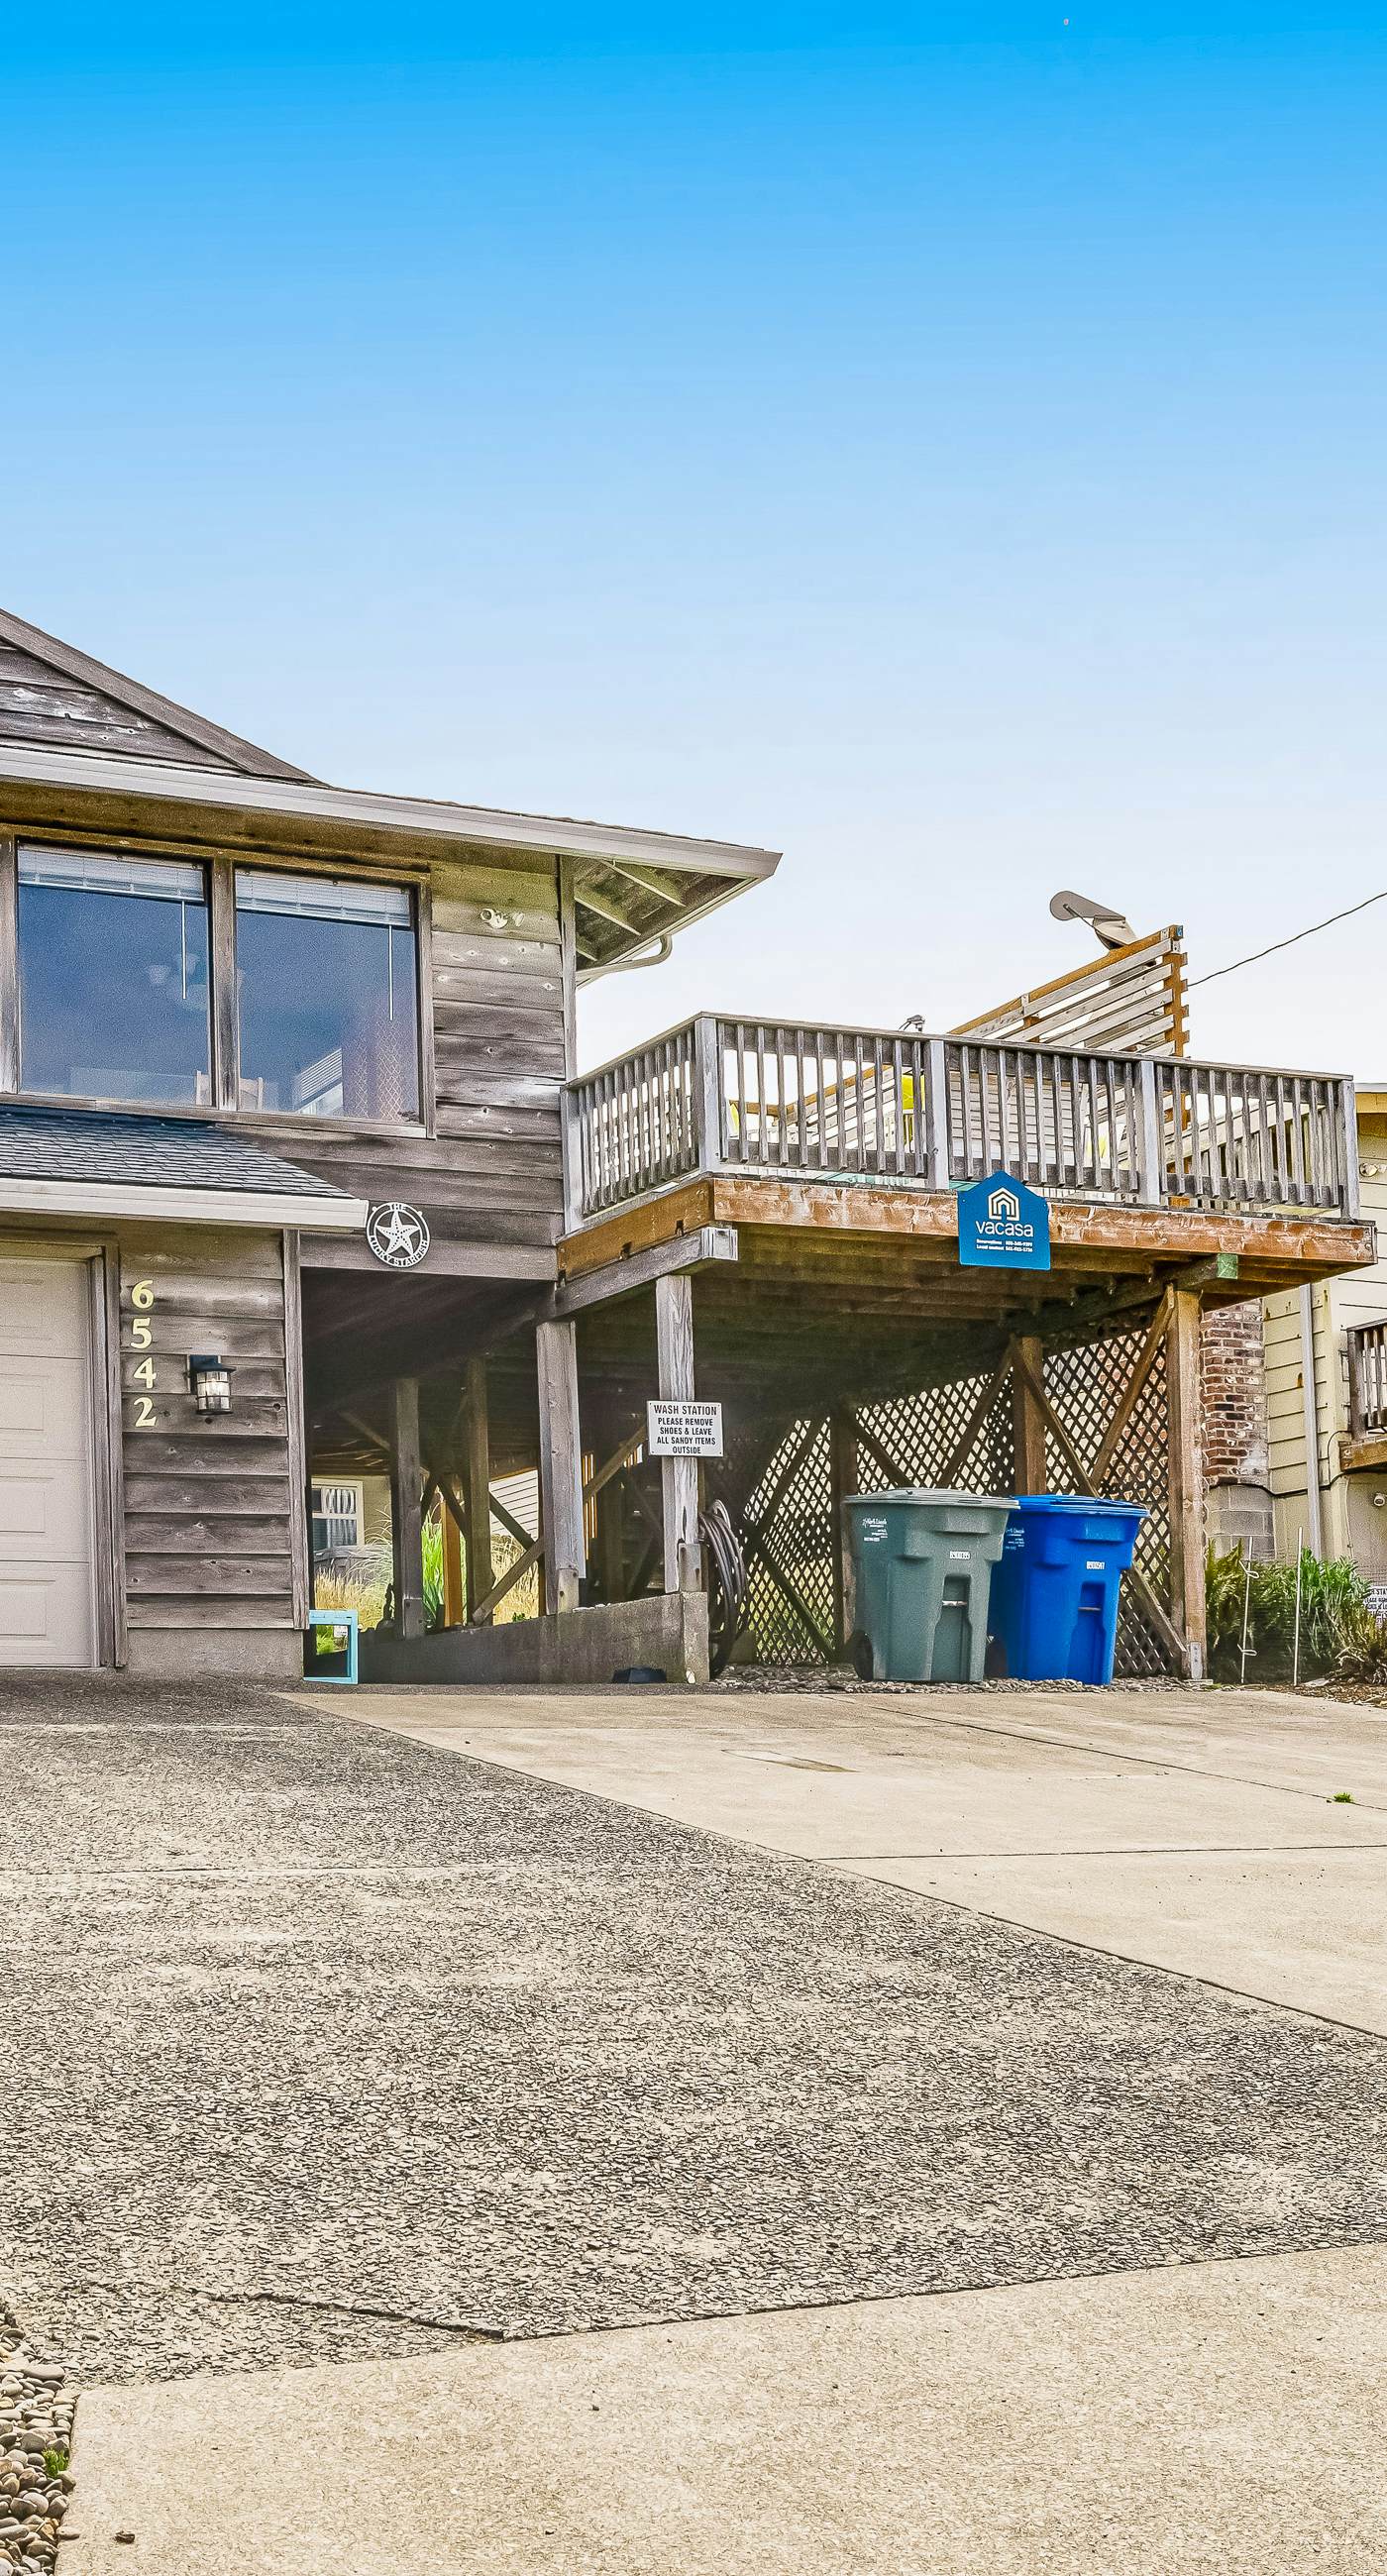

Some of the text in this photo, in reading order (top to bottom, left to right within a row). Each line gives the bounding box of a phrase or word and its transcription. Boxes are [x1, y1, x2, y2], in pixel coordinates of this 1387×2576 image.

[975, 1220, 1033, 1237] vacasa
[654, 1405, 717, 1415] WASH STATION
[658, 1417, 683, 1426] PLEASE
[684, 1427, 690, 1436] &
